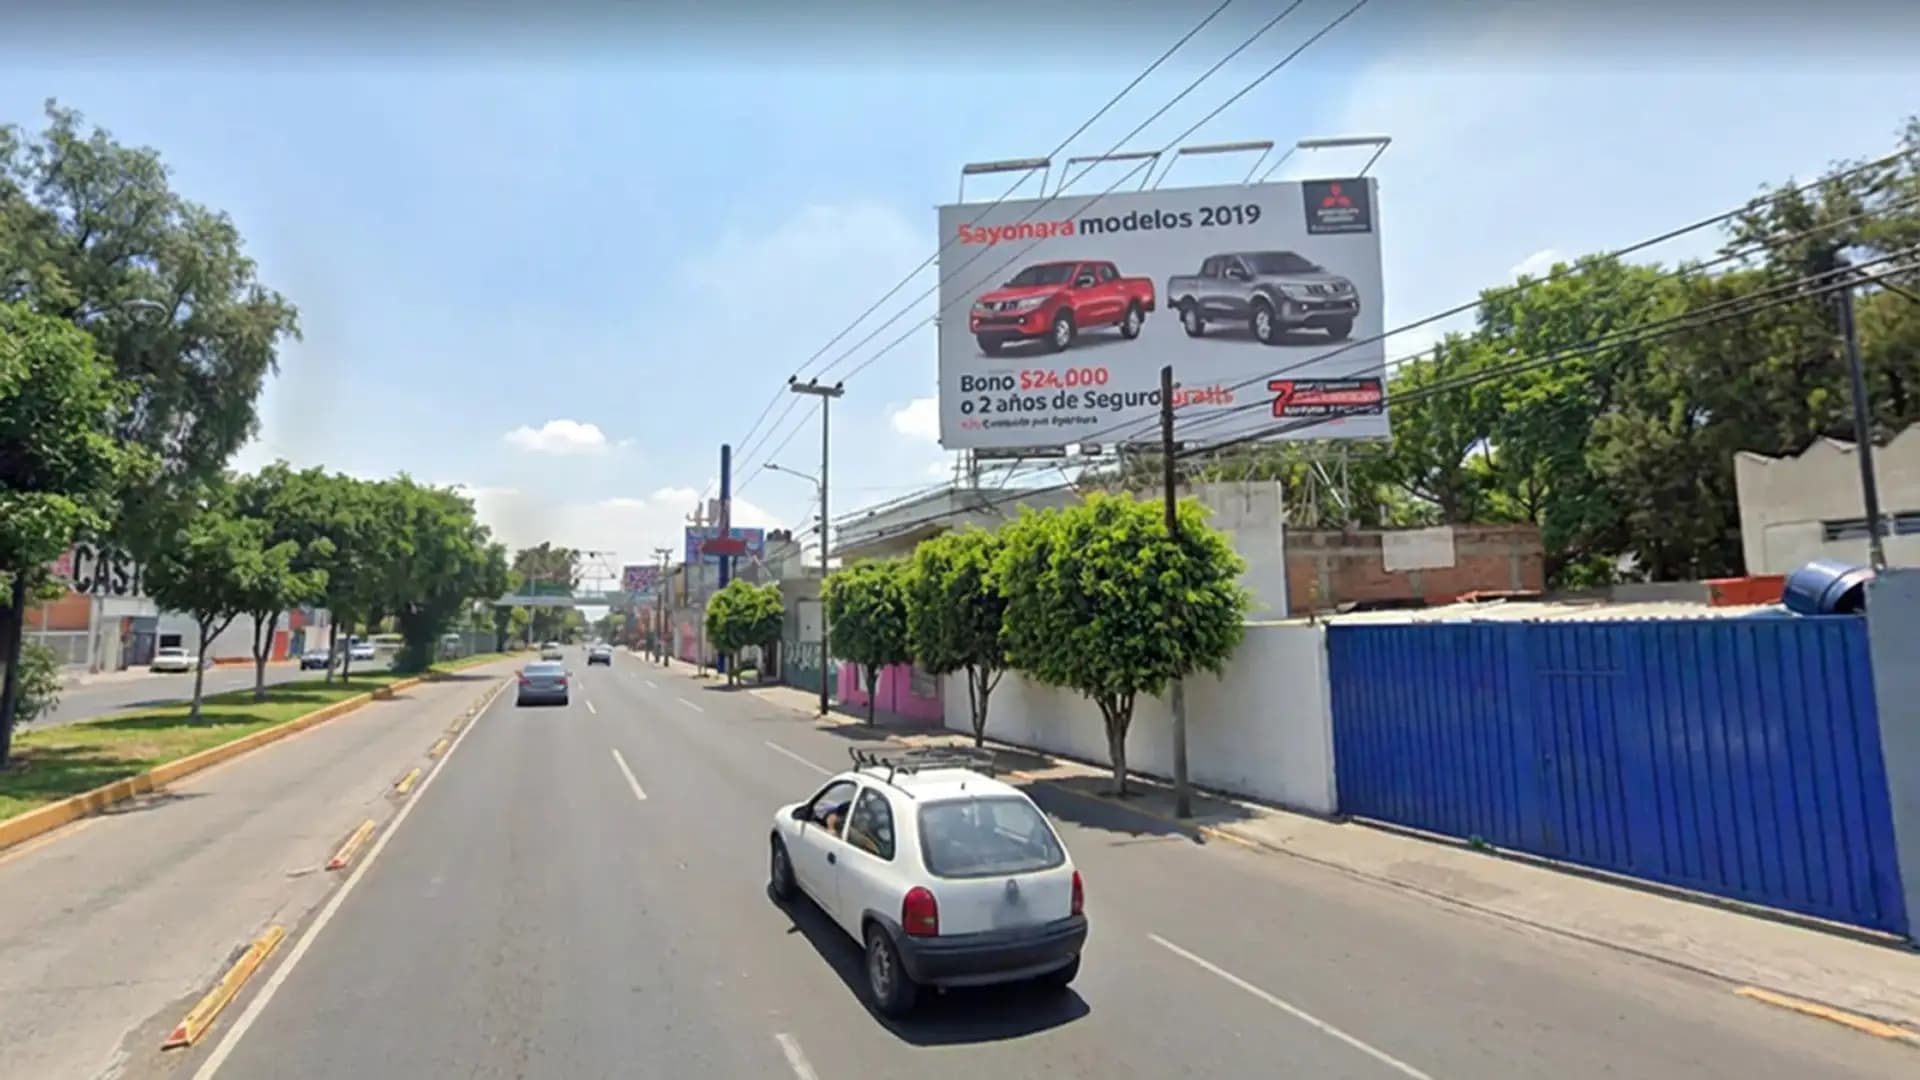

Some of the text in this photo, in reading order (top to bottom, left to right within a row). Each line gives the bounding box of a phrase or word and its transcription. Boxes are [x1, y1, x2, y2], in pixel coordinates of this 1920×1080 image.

[957, 203, 1262, 246] Sayonara modelos 2019
[960, 374, 1016, 393] Bono
[960, 401, 975, 415] o
[978, 396, 992, 414] 2
[996, 392, 1047, 412] años
[1051, 390, 1079, 411] de
[1083, 388, 1162, 412] Seguro
